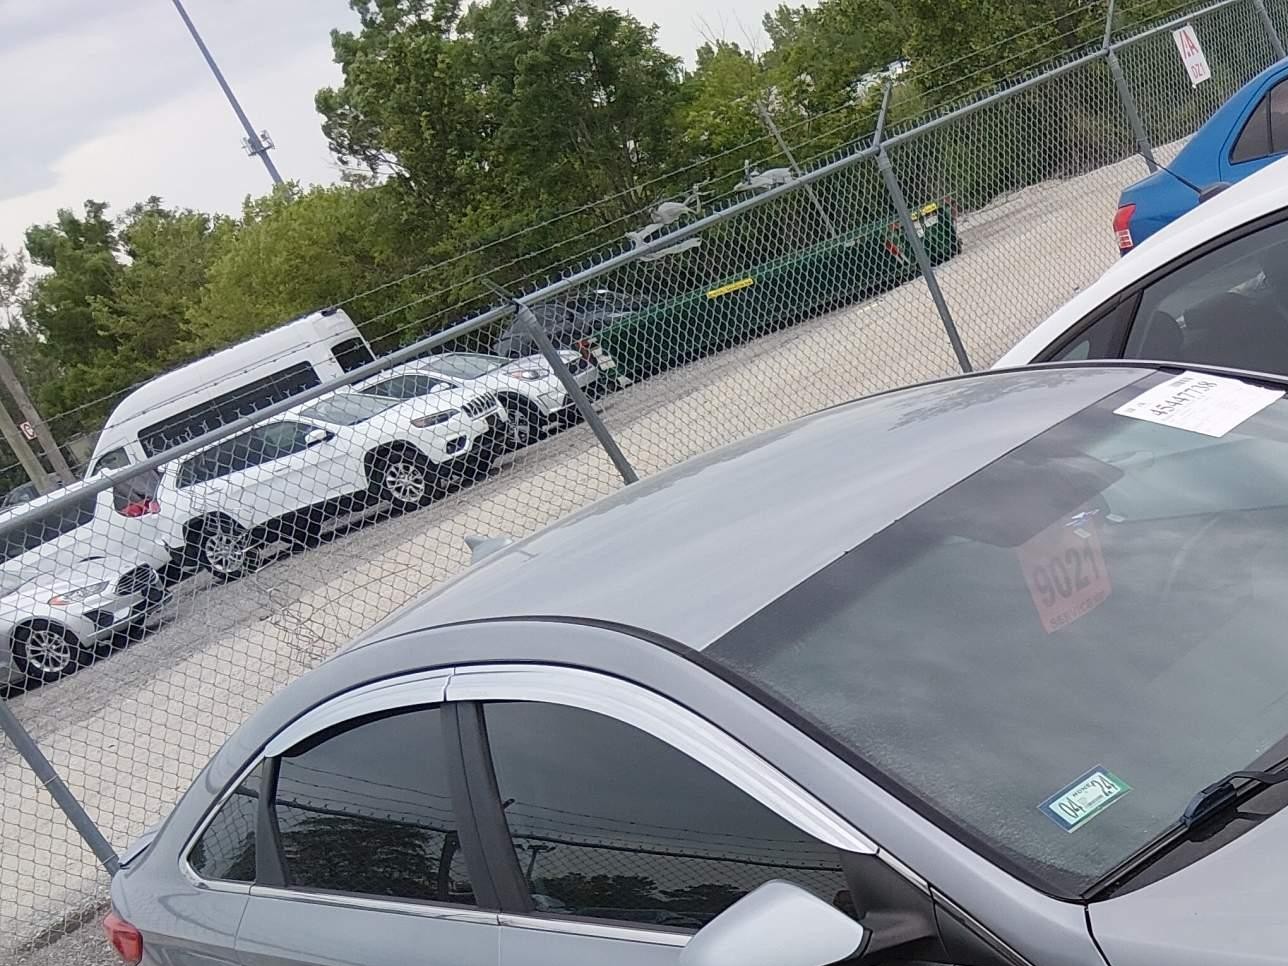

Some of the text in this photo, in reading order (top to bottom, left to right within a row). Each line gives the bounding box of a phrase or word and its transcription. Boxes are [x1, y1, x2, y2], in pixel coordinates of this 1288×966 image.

[1150, 380, 1219, 417] 45447738
[1033, 542, 1099, 608] 9021
[1058, 797, 1086, 818] 04
[1090, 775, 1118, 796] 24
